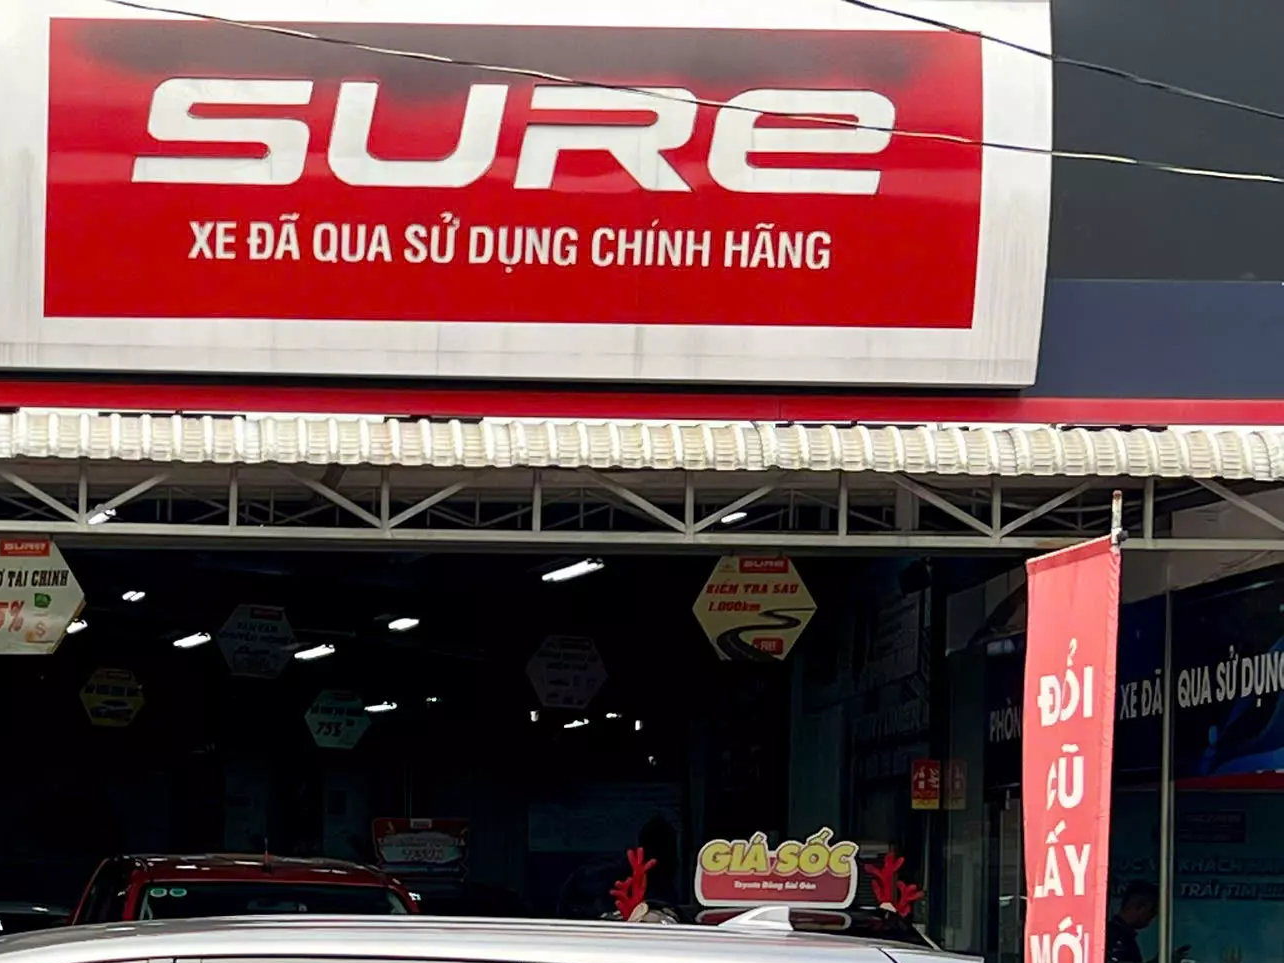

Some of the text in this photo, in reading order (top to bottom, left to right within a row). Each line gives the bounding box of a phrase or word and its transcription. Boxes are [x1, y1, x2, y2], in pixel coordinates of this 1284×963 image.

[188, 211, 831, 273] XE ĐÃ QUA SỬ DỤNG CHÍNH HÃNG
[1036, 638, 1095, 727] ĐỔI
[1119, 681, 1138, 720] XE
[1177, 665, 1212, 708] QUA
[1216, 645, 1239, 702] SỬ
[700, 828, 858, 876] GIÁ SỐC
